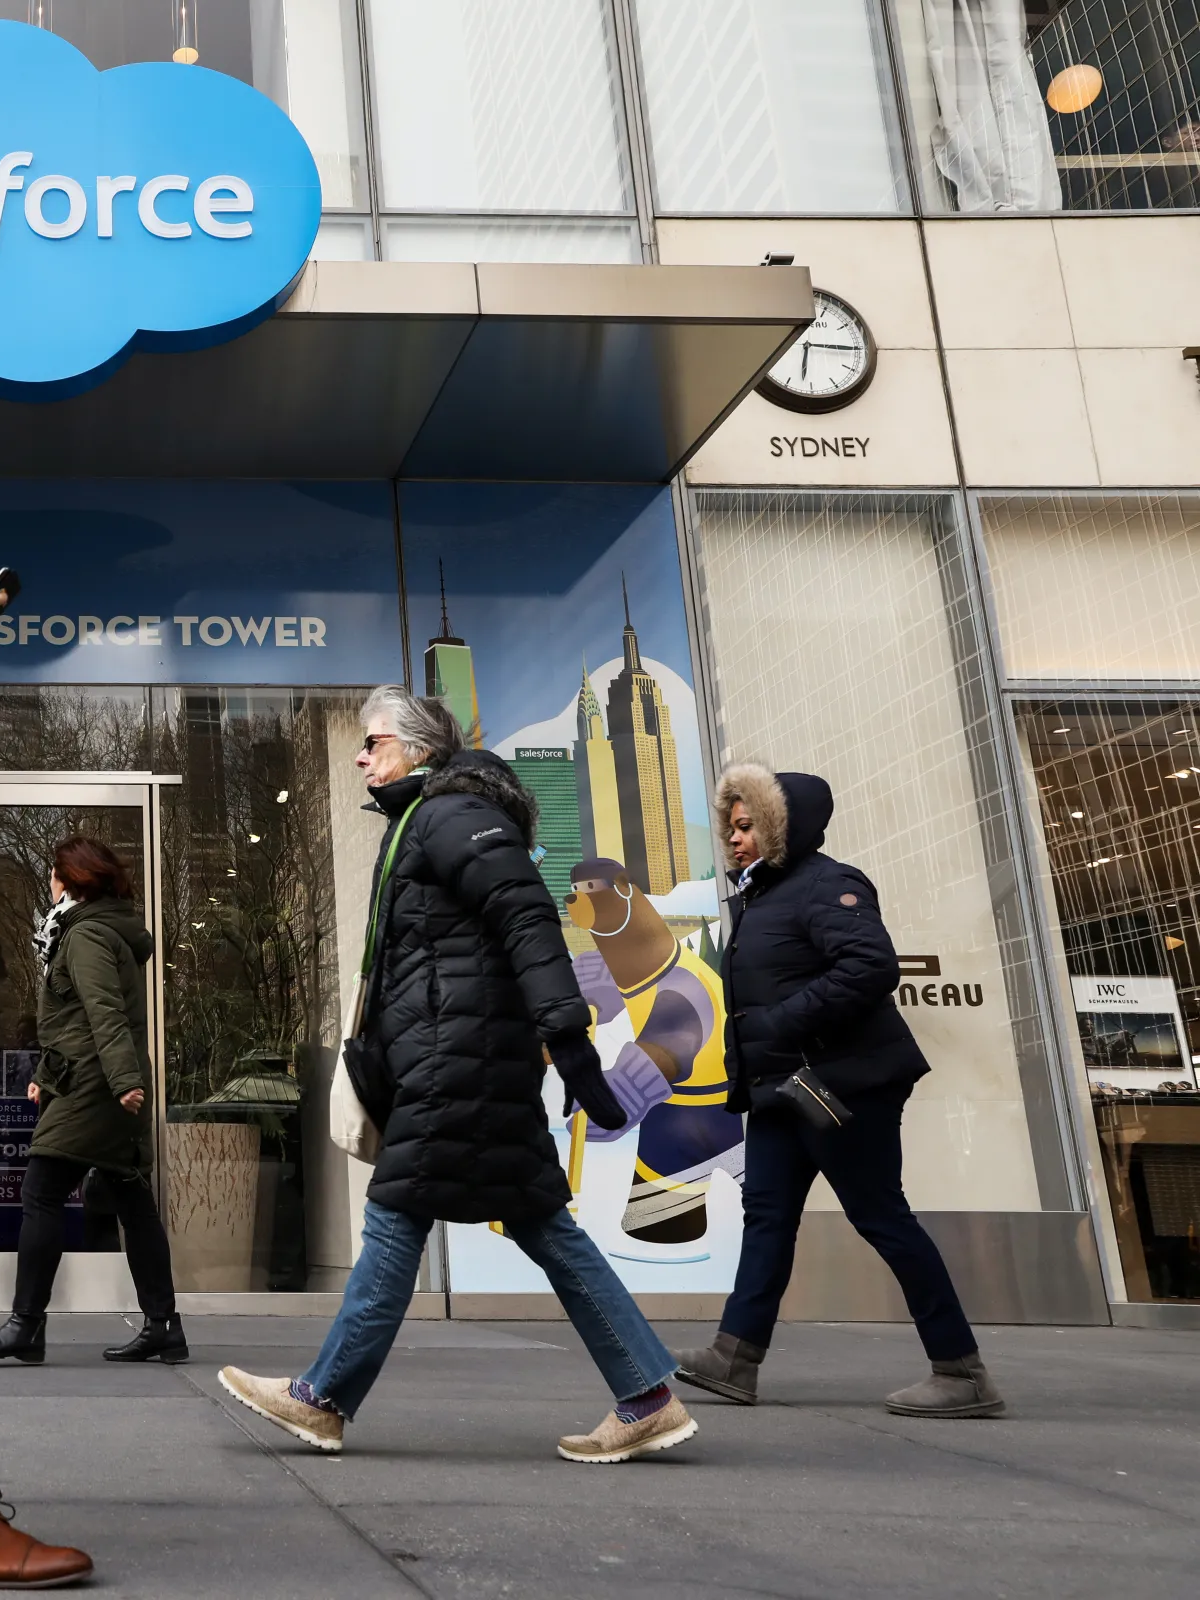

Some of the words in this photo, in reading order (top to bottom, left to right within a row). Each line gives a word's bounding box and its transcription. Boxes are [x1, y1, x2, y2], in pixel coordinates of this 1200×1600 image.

[770, 436, 870, 457] SYDNEY
[173, 616, 327, 647] TOWER
[519, 749, 563, 760] salesforce
[477, 827, 503, 838] Columbia
[1096, 984, 1127, 996] IWC
